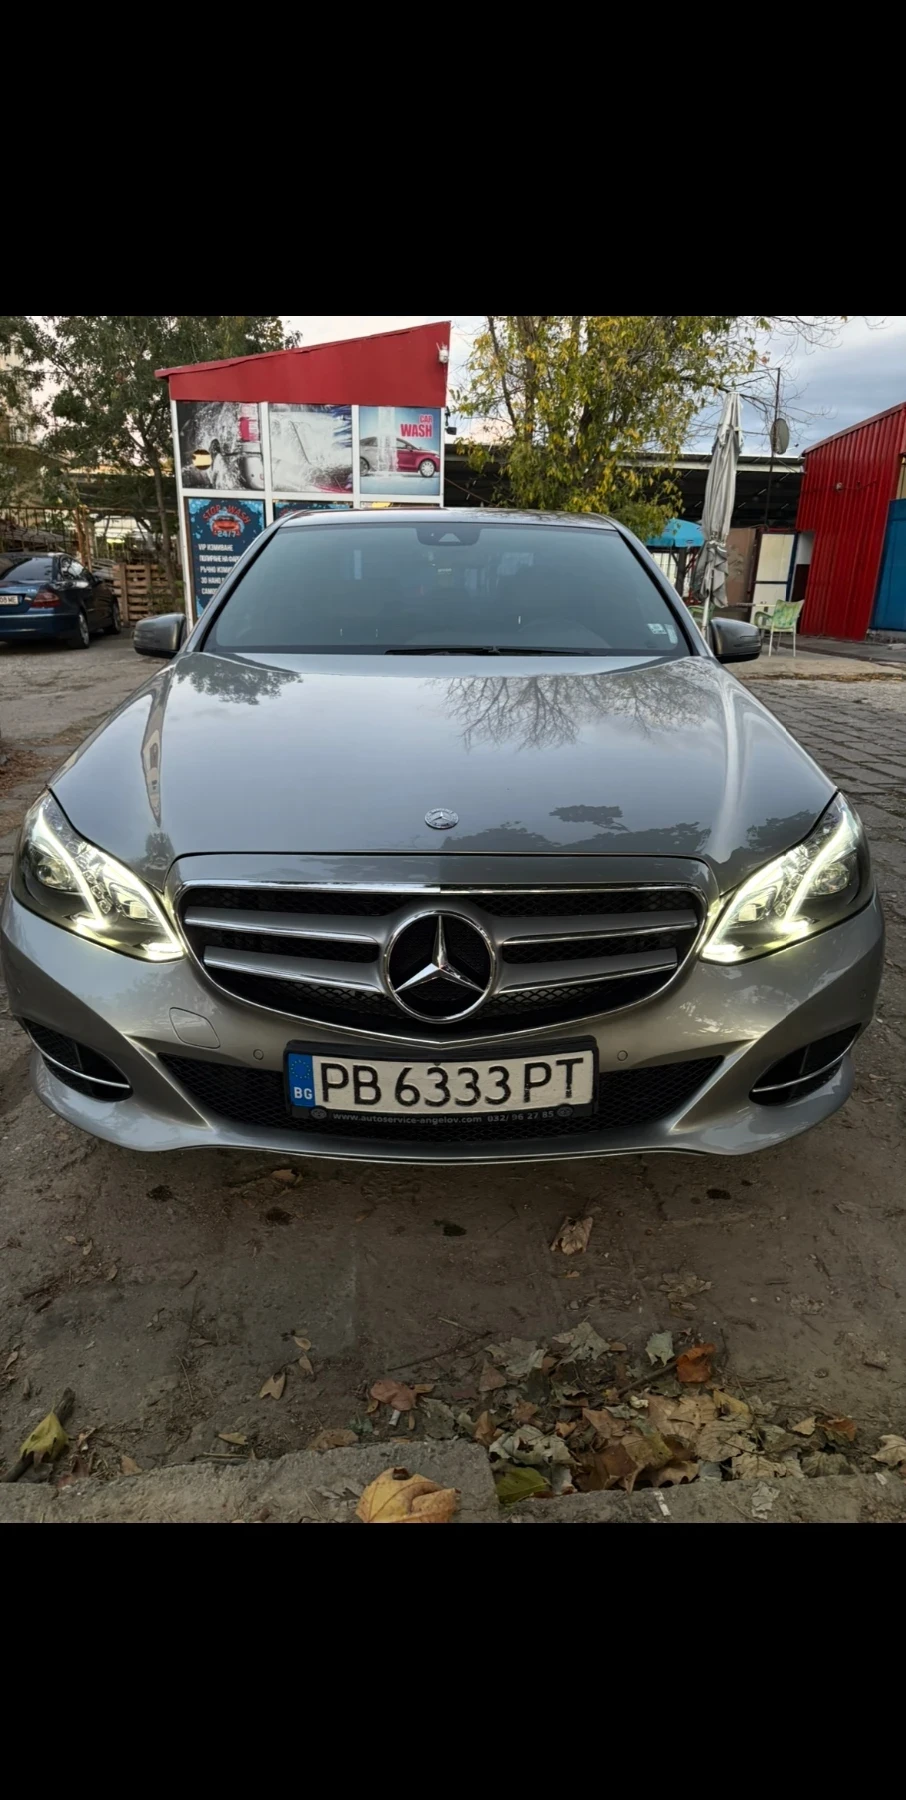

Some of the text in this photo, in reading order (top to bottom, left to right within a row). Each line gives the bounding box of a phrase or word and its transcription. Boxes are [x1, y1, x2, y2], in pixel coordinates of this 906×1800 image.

[419, 414, 433, 423] CAR
[400, 423, 433, 437] WASH
[202, 504, 251, 524] STOP WASH
[217, 530, 236, 538] 24/7
[320, 1057, 584, 1107] PB 6333 PT
[293, 1086, 313, 1100] BG
[333, 1112, 482, 1125] www.autoservice-angelov.com
[511, 1112, 524, 1121] 96
[527, 1111, 539, 1120] 27
[542, 1110, 554, 1119] 85
